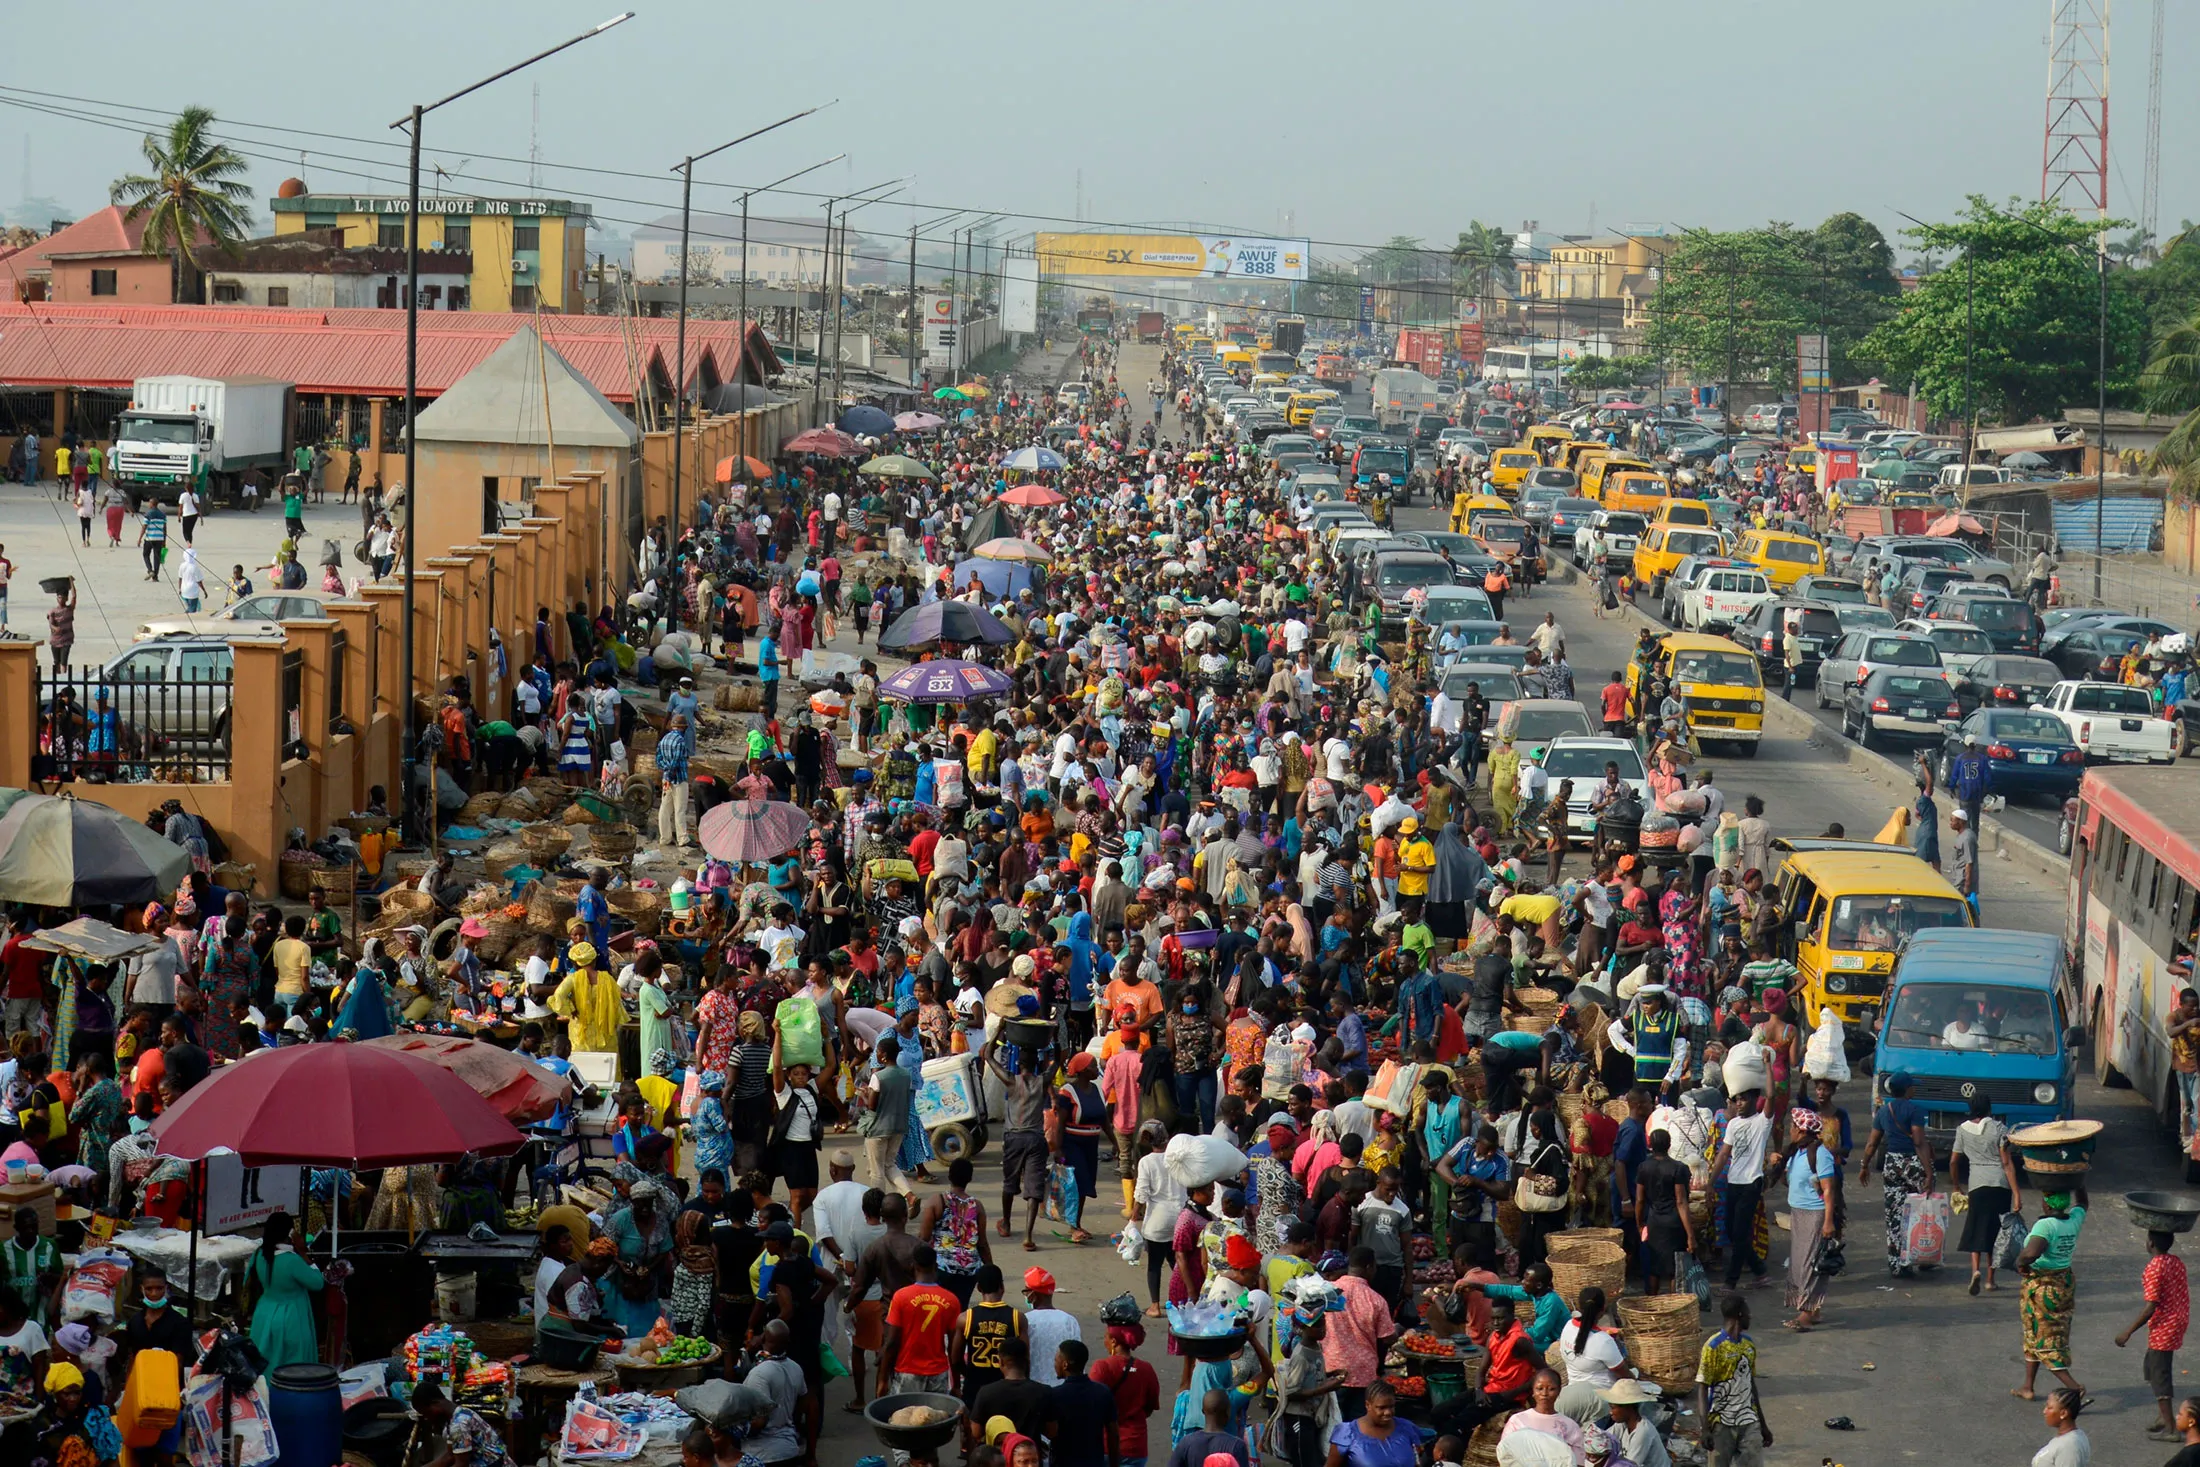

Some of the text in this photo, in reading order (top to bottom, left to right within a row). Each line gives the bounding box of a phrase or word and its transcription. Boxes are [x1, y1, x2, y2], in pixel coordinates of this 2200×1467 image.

[486, 201, 510, 214] NIG
[520, 201, 547, 214] LTD
[1106, 249, 1133, 264] 5X
[1245, 262, 1275, 274] 888
[931, 681, 951, 691] 3X
[1964, 762, 1979, 780] 15
[910, 1293, 951, 1309] DAVID VILLA
[921, 1304, 939, 1332] 7
